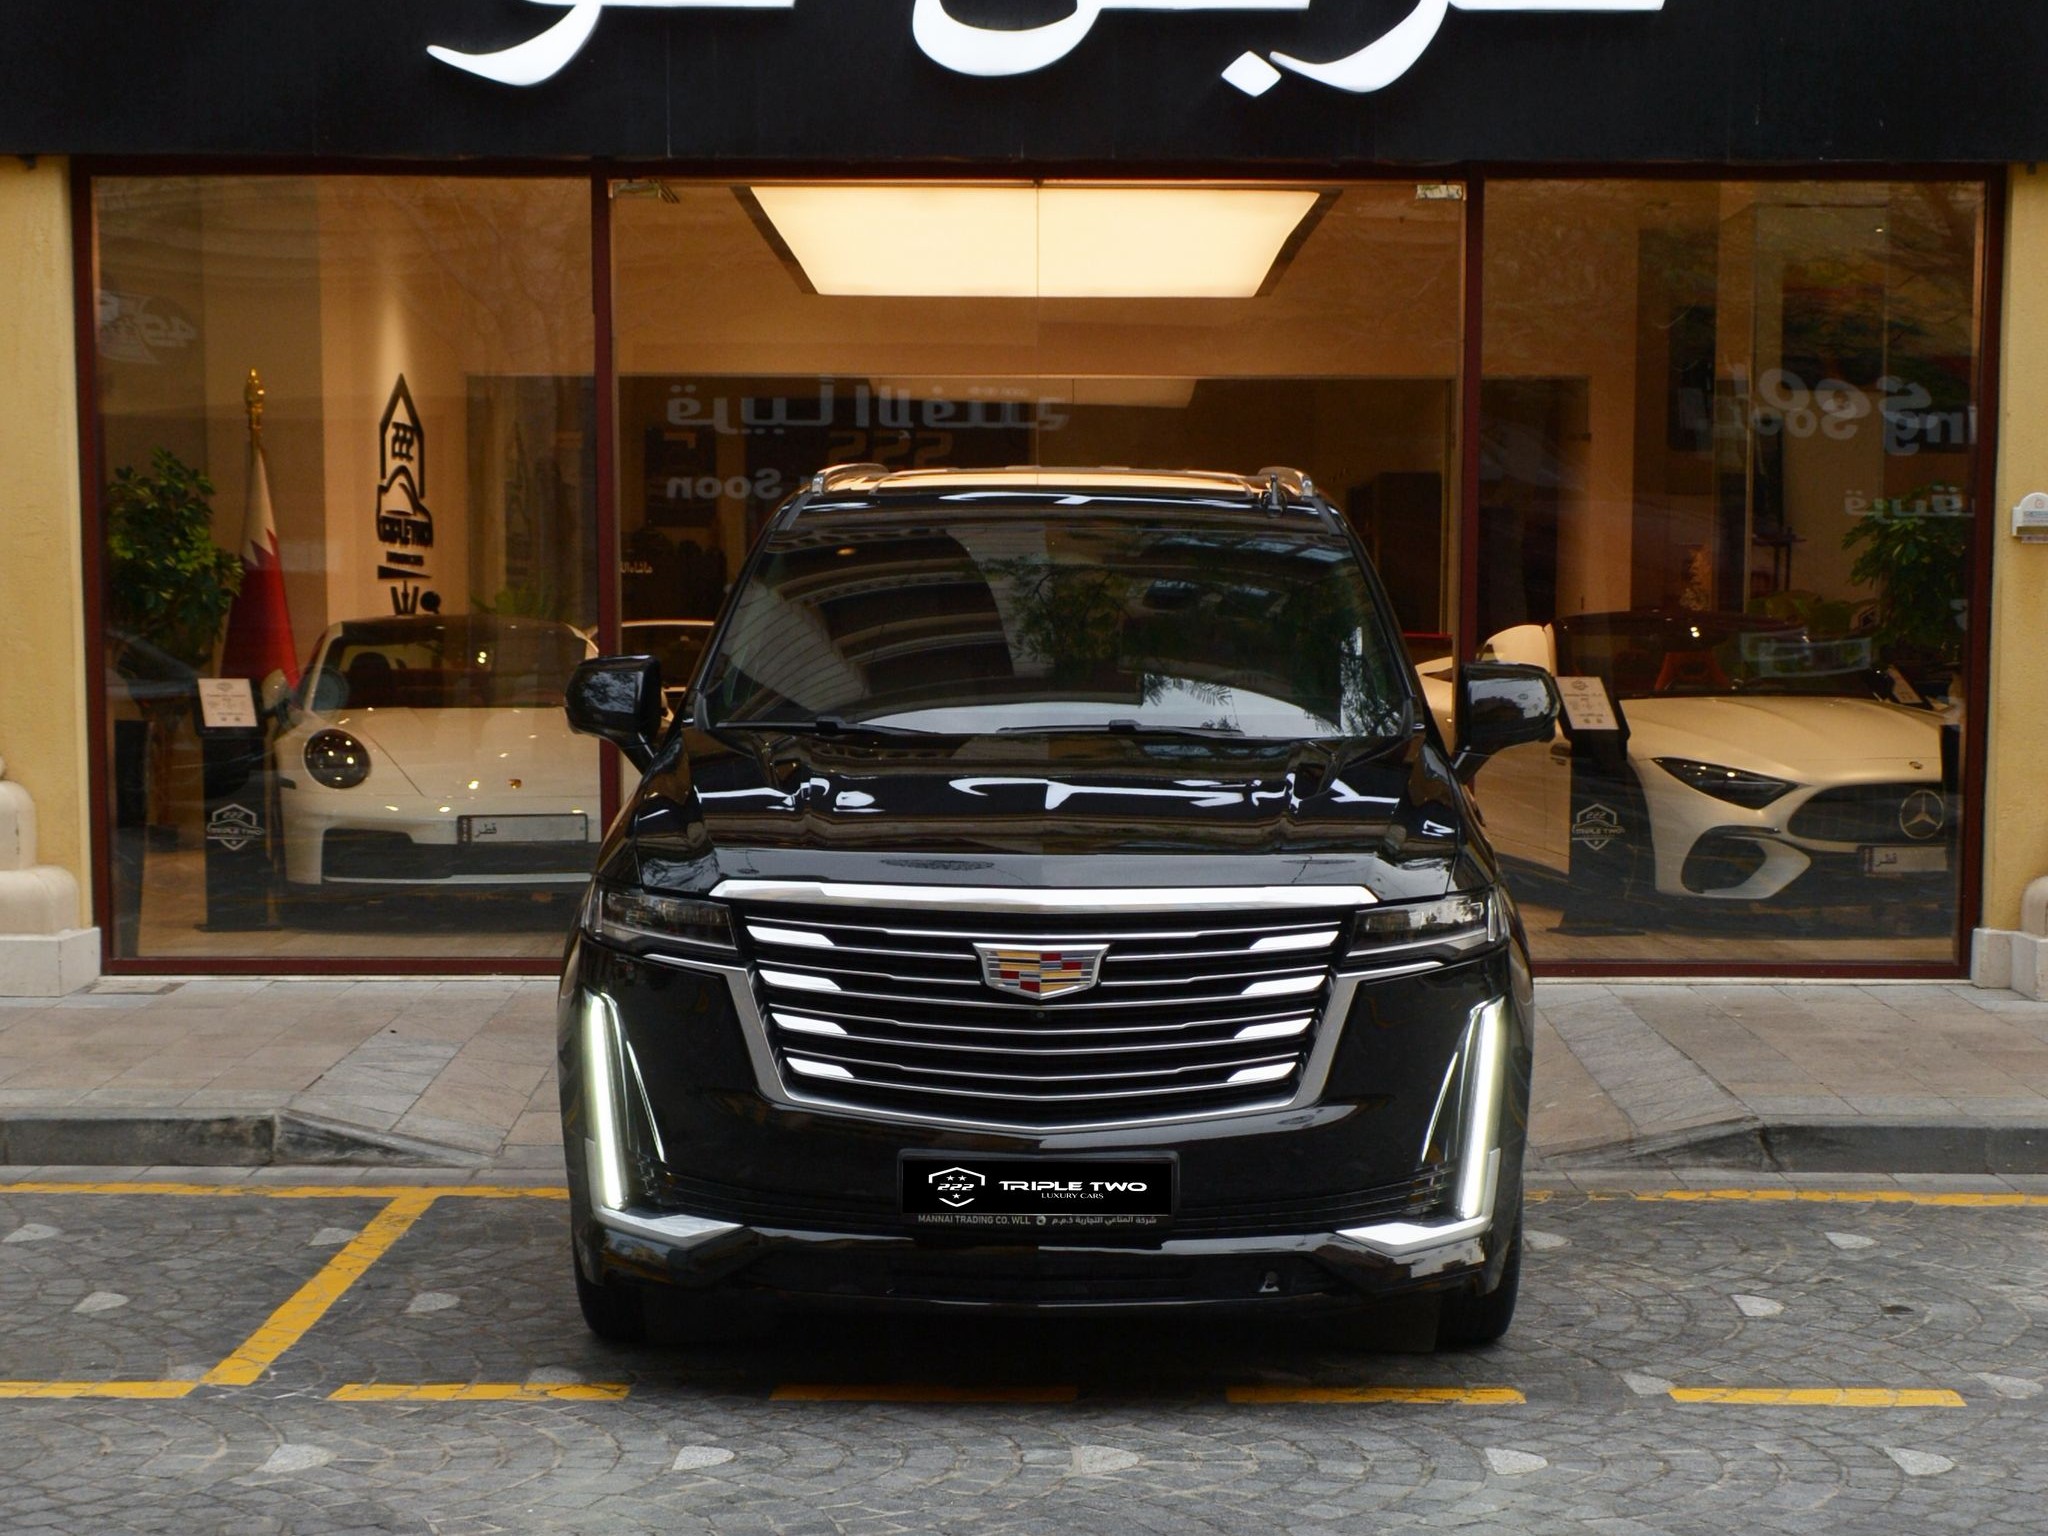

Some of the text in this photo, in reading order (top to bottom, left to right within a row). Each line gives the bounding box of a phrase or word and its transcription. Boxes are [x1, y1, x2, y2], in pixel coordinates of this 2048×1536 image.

[937, 1183, 975, 1191] 222
[998, 1181, 1148, 1192] TRIPLE TWO
[917, 1214, 1031, 1225] MANNAI TRADING CO. WLL
[1135, 1216, 1157, 1225] شركة
